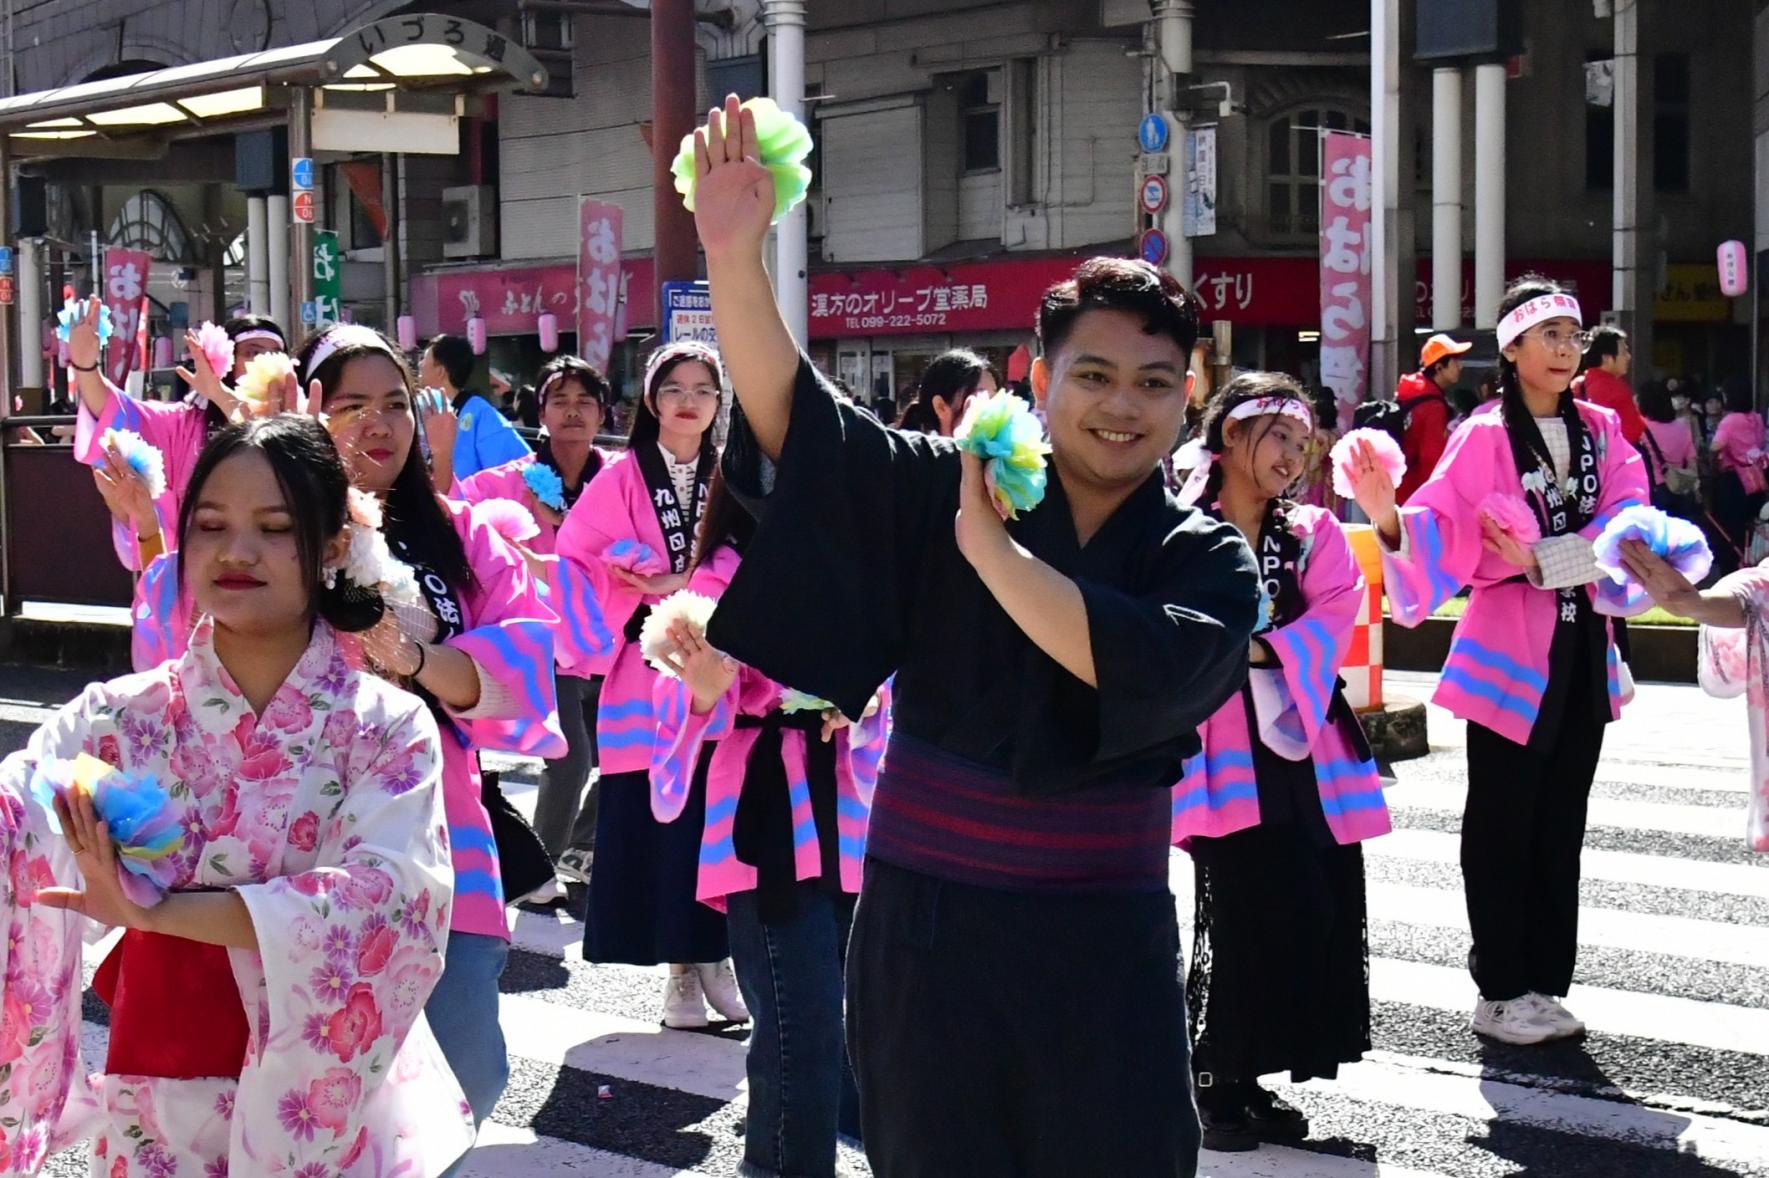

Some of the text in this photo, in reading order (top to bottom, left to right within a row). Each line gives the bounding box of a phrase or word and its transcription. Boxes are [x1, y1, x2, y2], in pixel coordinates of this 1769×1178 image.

[1193, 271, 1253, 310] くすり
[846, 313, 946, 328] TEL 099-222-5072
